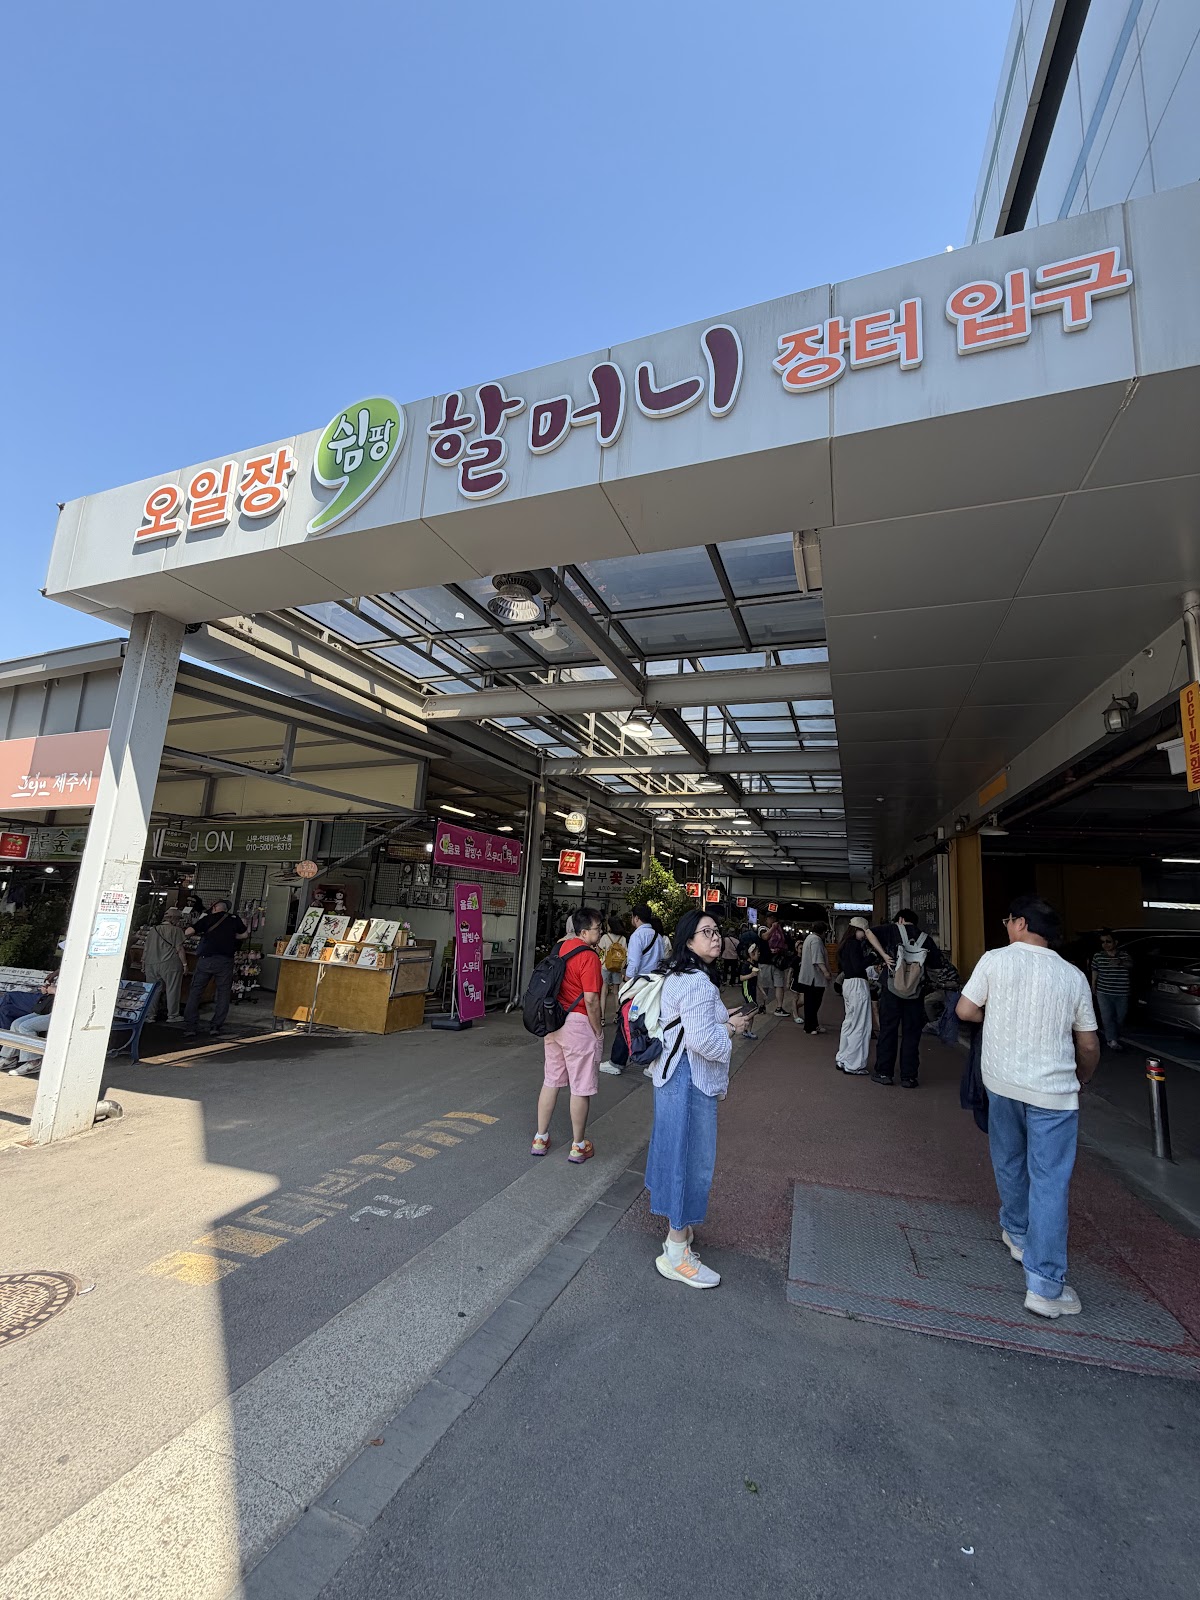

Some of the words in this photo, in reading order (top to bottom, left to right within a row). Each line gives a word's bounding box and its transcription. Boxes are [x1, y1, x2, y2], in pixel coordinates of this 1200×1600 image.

[135, 444, 297, 543] 오일장
[328, 408, 396, 474] 쉼팡
[427, 323, 743, 500] 할머니
[773, 297, 923, 391] 장터
[946, 246, 1133, 358] 입구
[17, 772, 48, 797] Jeju
[53, 770, 93, 793] 제주시
[204, 829, 235, 852] ON
[448, 842, 461, 855] 음료
